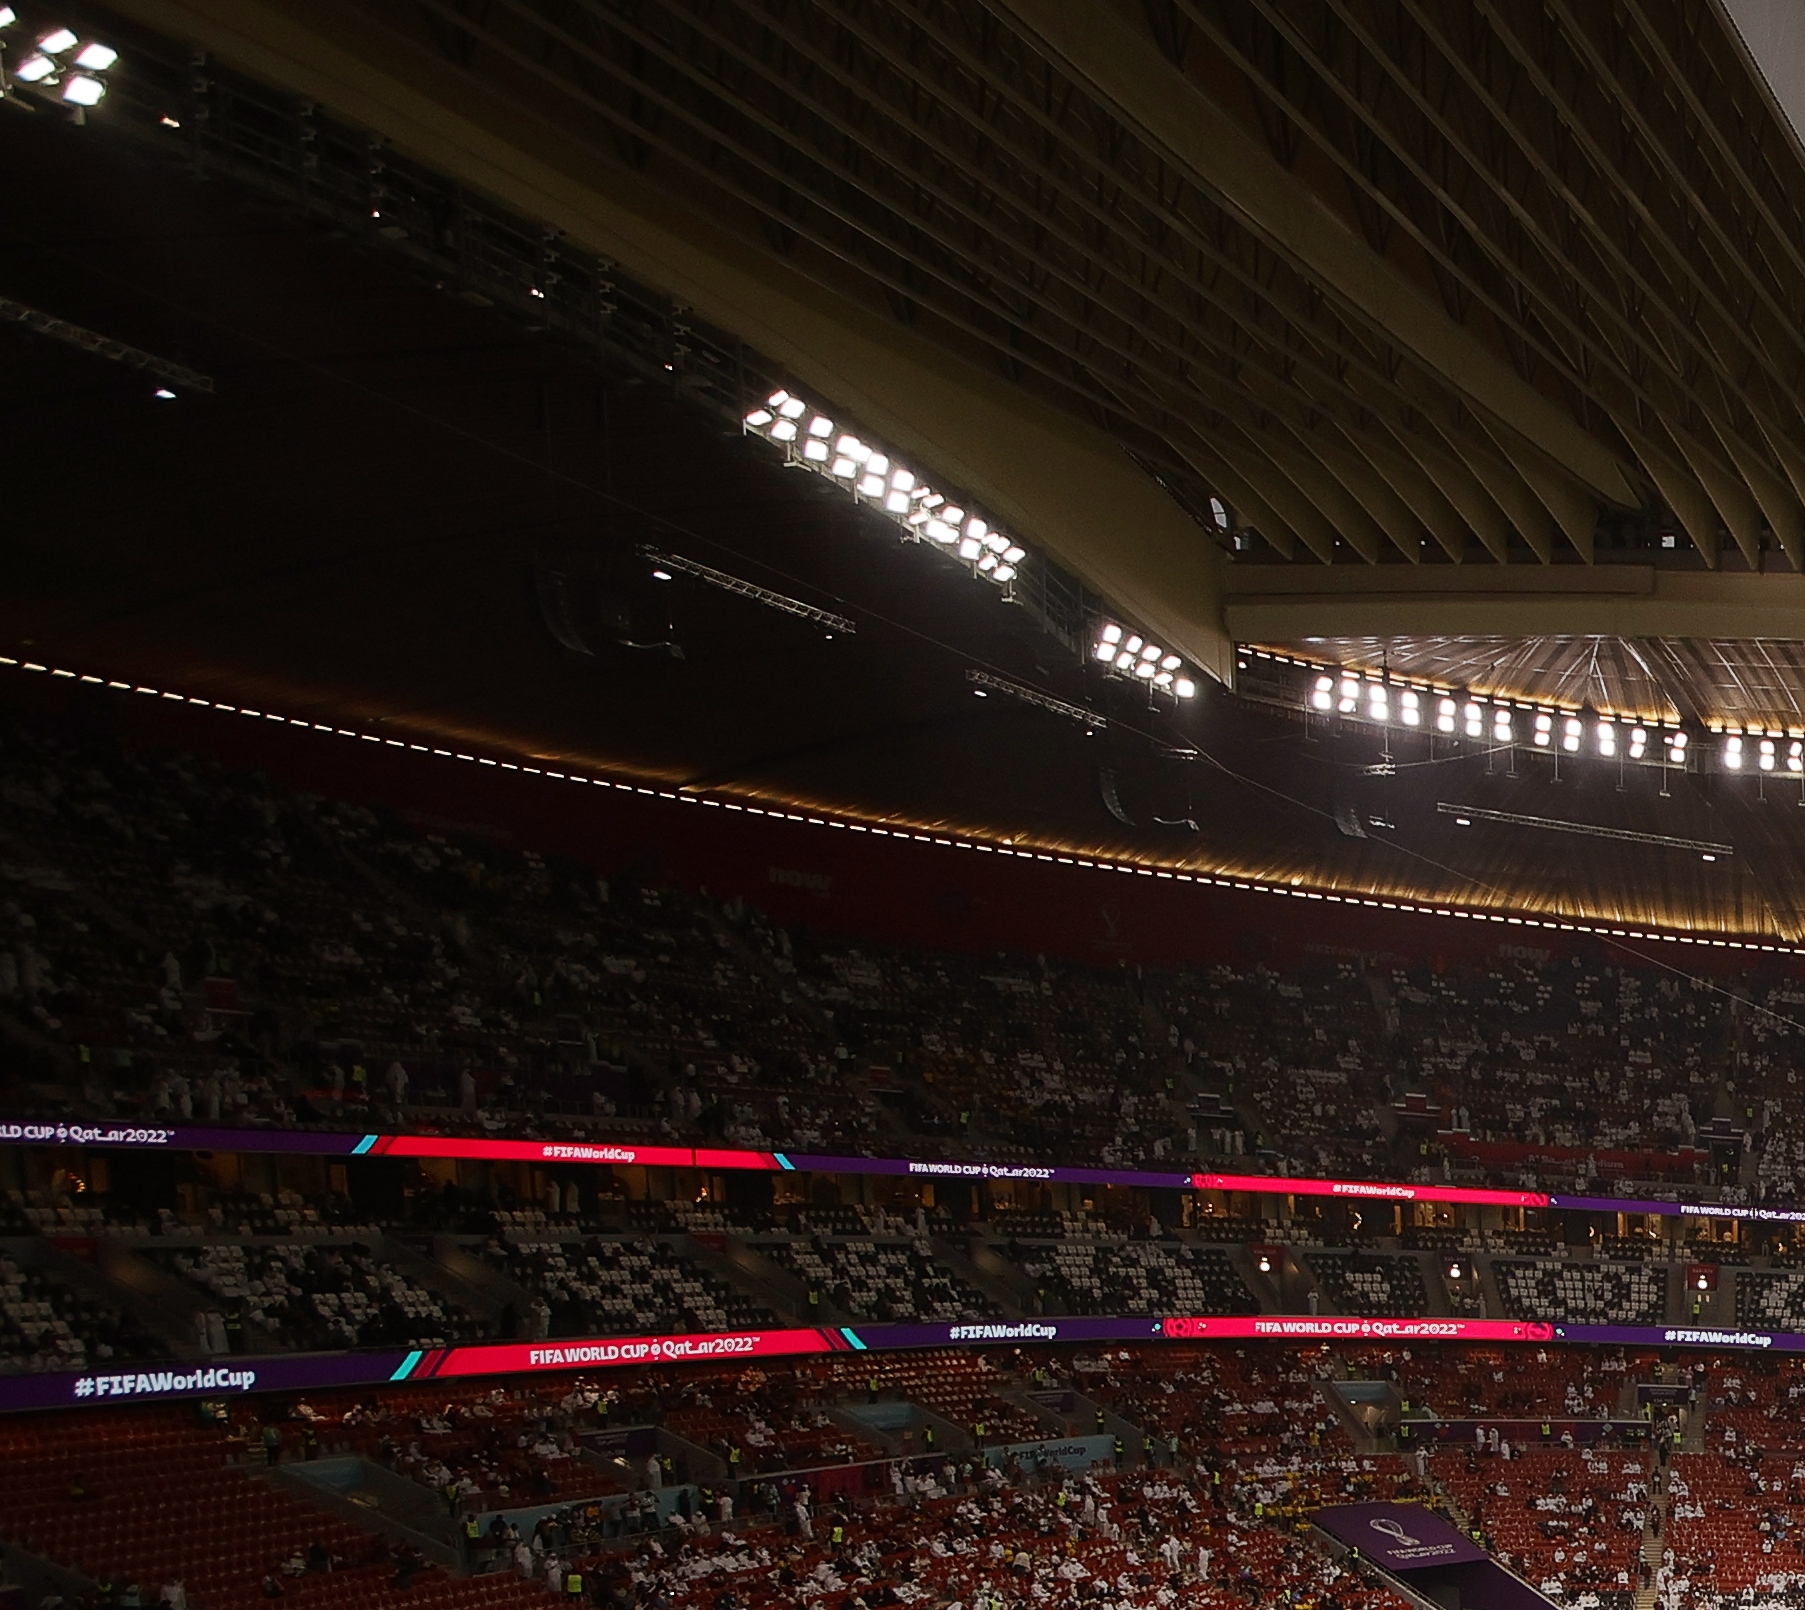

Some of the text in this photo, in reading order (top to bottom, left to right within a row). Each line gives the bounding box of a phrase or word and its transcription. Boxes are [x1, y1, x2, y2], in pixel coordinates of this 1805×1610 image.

[26, 1126, 57, 1139] CUP
[543, 1146, 635, 1162] #FIFAWorldCup
[909, 1163, 928, 1173] FIFA
[928, 1164, 961, 1174] WORLD
[963, 1164, 981, 1175] CUP
[1333, 1184, 1415, 1198] #FIFAWorldCup
[1680, 1206, 1700, 1214] FIFA
[1700, 1206, 1731, 1216] WORLD
[1732, 1208, 1749, 1217] CUP
[950, 1323, 1058, 1340] #FIFAWorldCup
[1255, 1322, 1281, 1333] FIFA
[1281, 1322, 1332, 1333] WORLD
[1333, 1322, 1360, 1333] CUP
[1664, 1330, 1772, 1347] #FIFAWorldCup
[530, 1349, 565, 1365] FIFA
[565, 1346, 619, 1362] WORLD
[621, 1343, 649, 1359] CUP
[75, 1368, 255, 1397] #FIFAWorldCup
